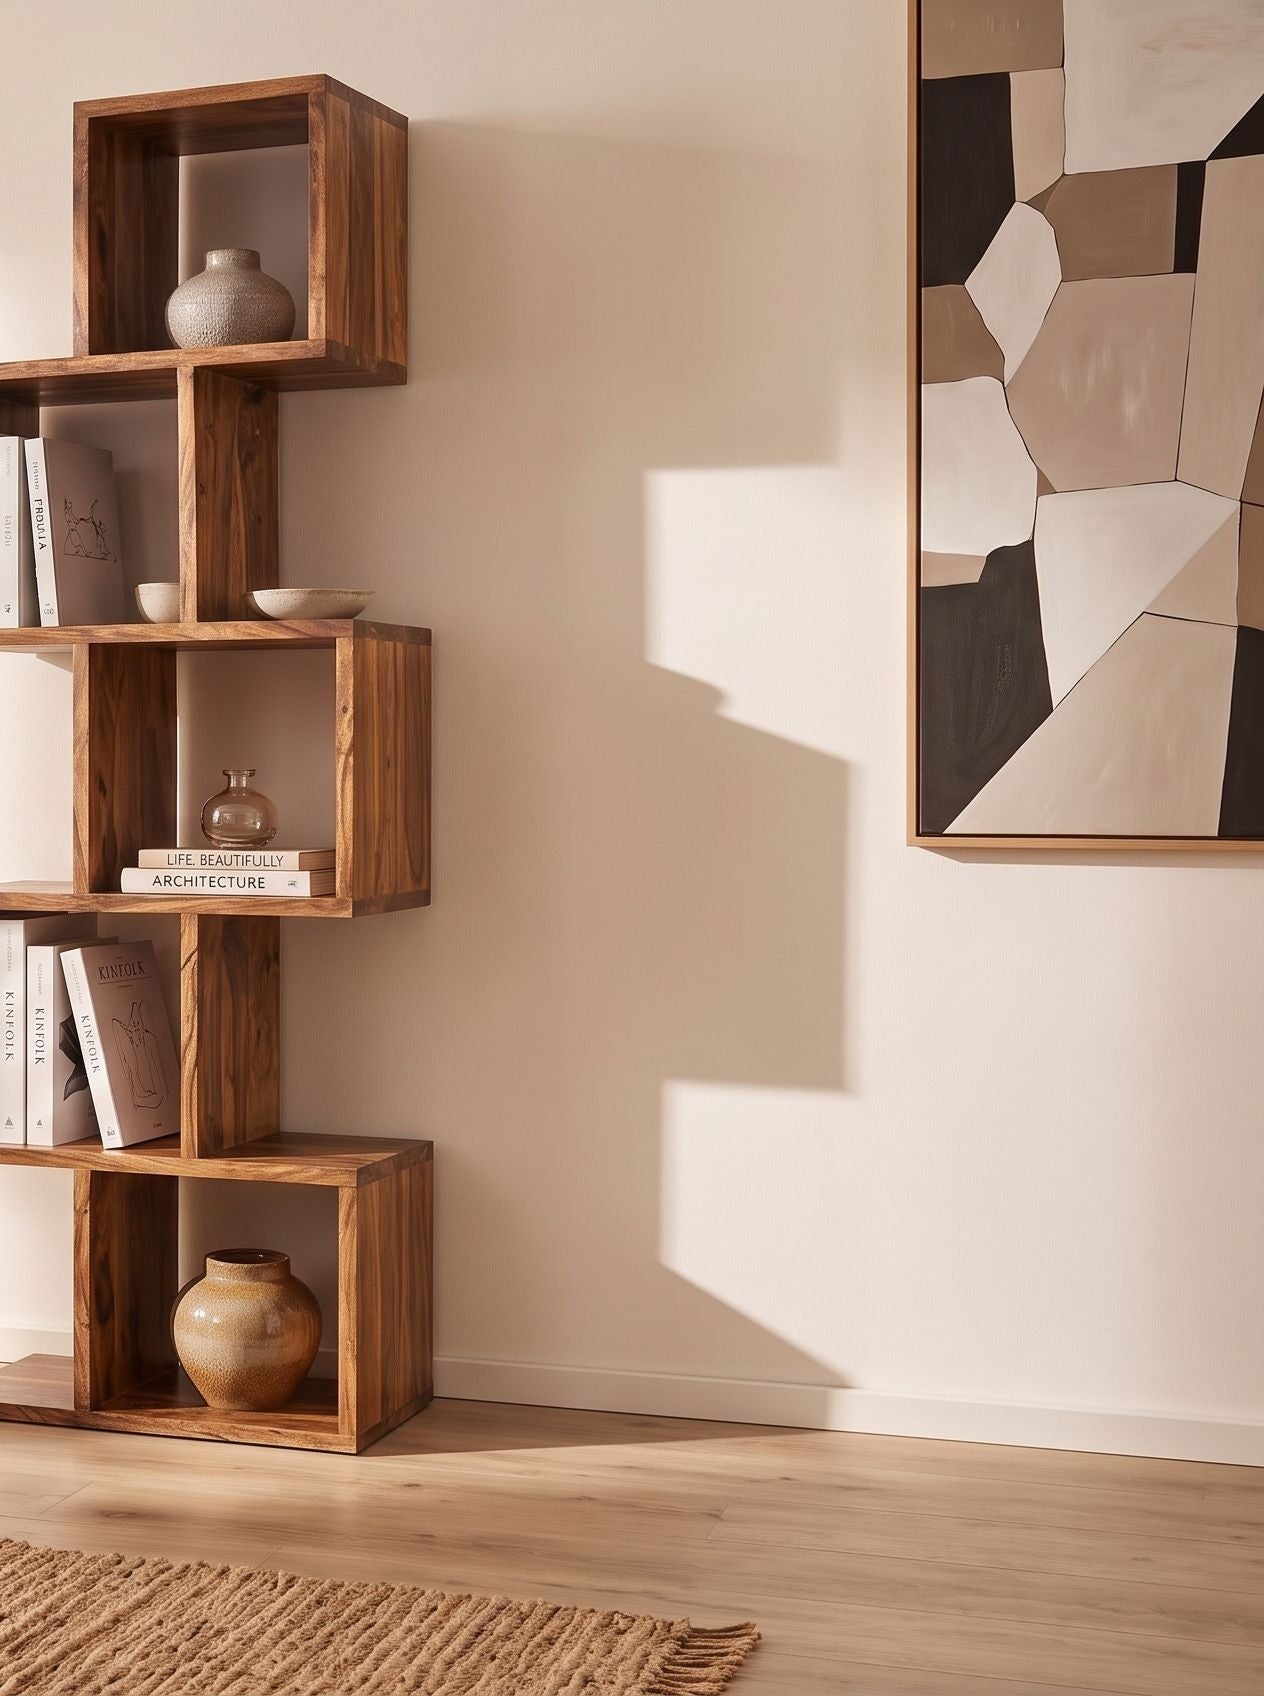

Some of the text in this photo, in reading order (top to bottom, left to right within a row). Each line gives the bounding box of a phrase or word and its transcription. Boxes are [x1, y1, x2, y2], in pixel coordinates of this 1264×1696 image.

[200, 854, 284, 868] BEAUTIFULLY
[152, 875, 266, 890] ARCHITECTURE
[97, 960, 146, 980] KINFOLK
[5, 991, 15, 1062] KINFOLK
[35, 1007, 45, 1065] KINFOLK
[81, 1014, 101, 1074] KINFOLK
